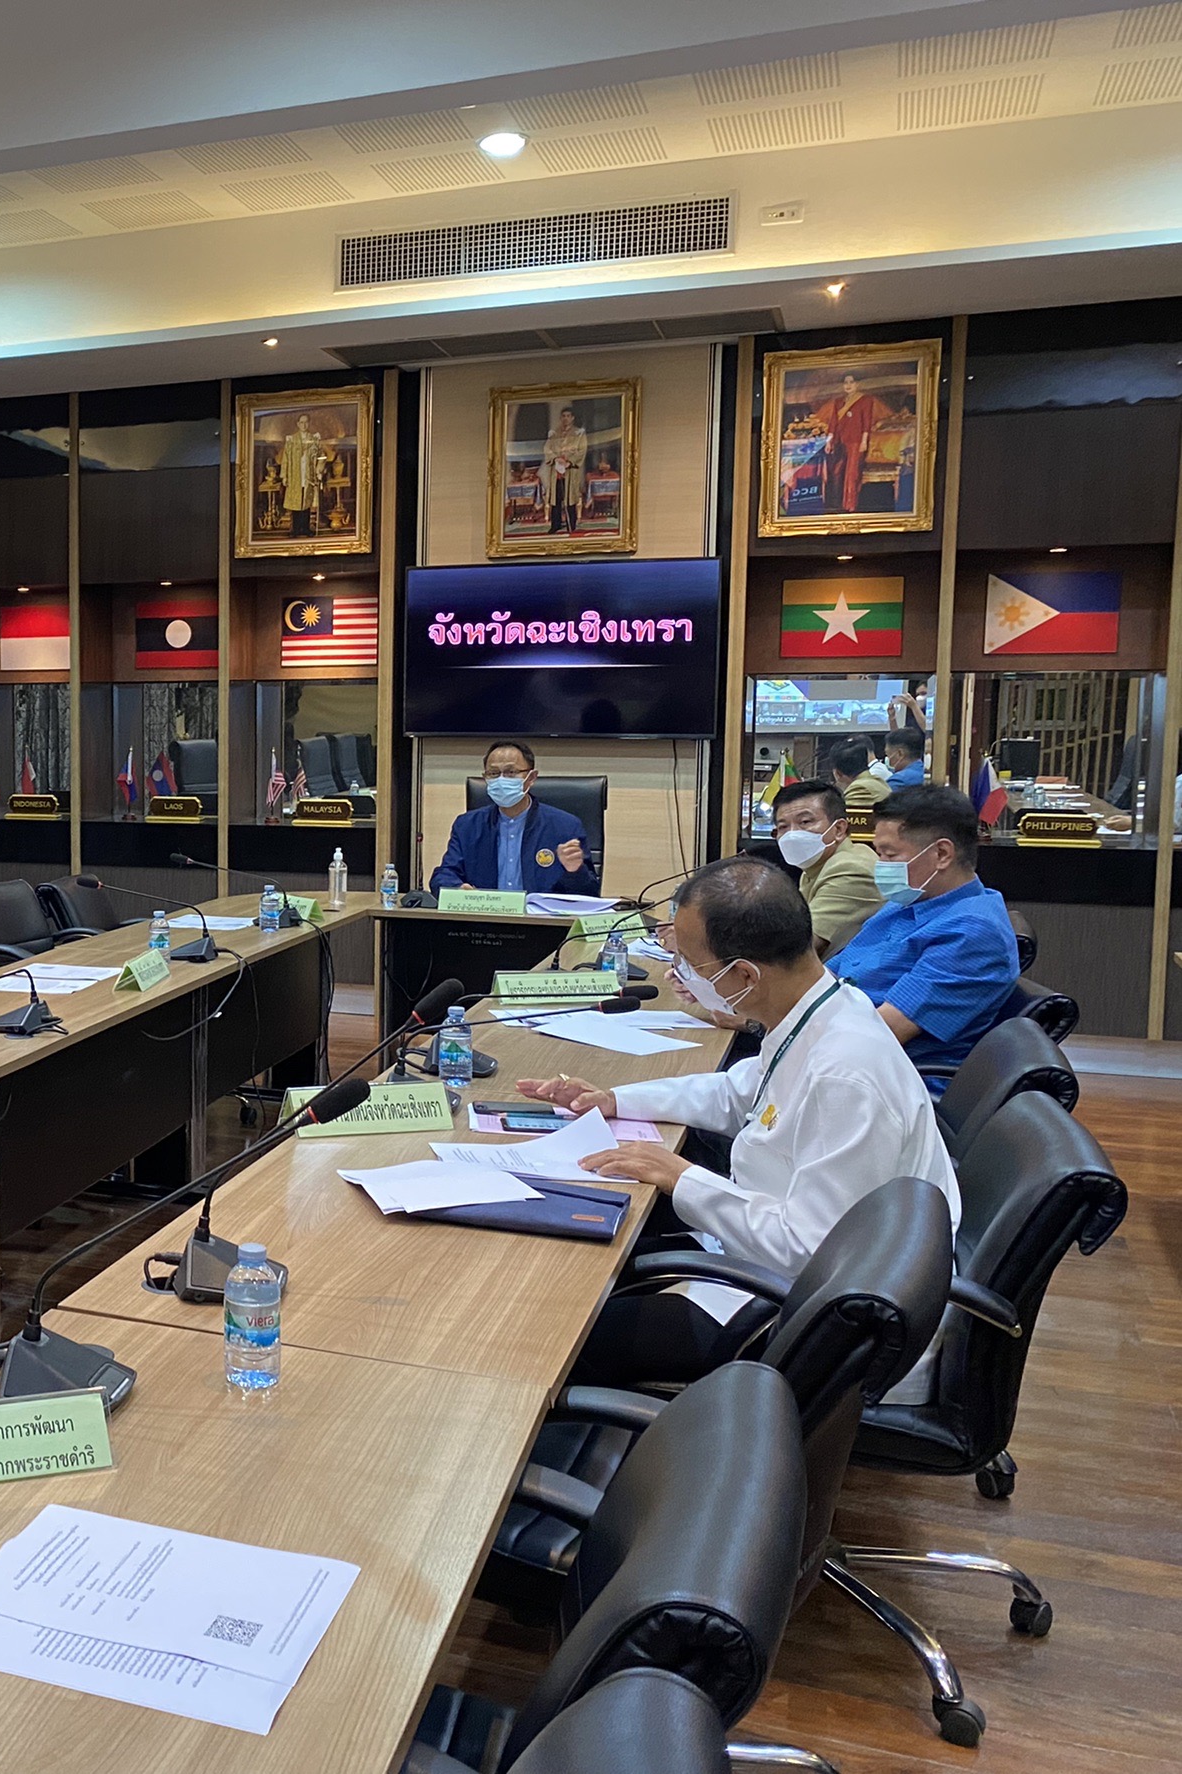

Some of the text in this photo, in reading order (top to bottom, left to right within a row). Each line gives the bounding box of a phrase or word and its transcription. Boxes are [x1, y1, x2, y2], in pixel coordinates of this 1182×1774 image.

[427, 610, 694, 646] จังหวัดฉะเชิงเทรา
[12, 799, 52, 809] INDONESIA
[163, 802, 184, 811] LAOS
[303, 804, 342, 814] MALAYSIA
[1025, 820, 1094, 833] PHILIPPINES
